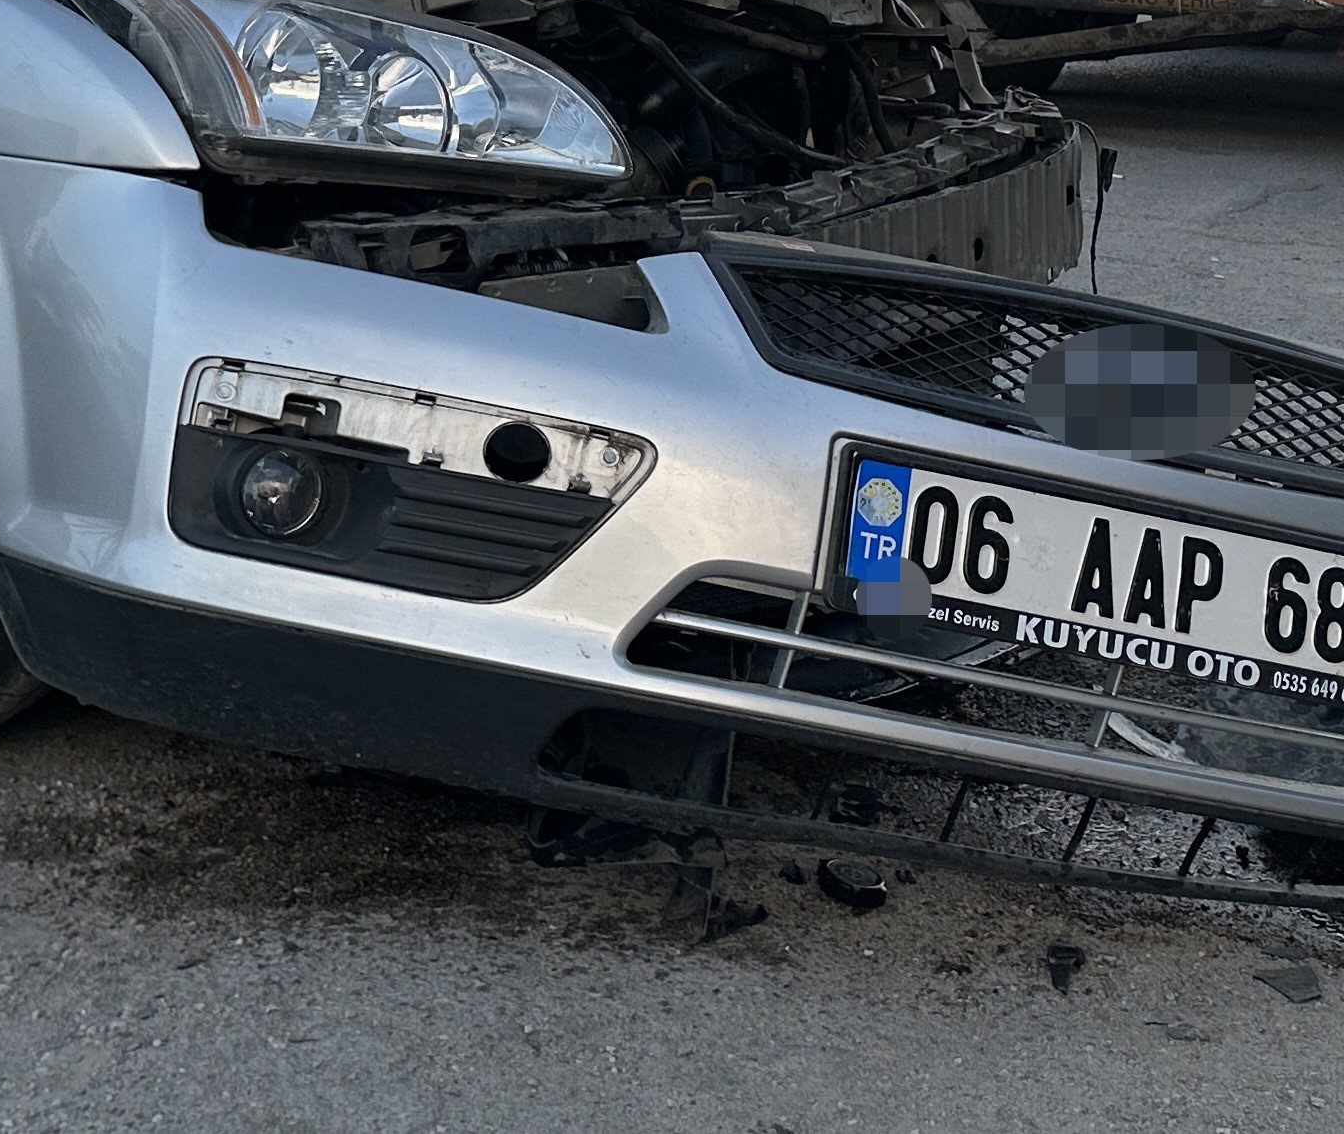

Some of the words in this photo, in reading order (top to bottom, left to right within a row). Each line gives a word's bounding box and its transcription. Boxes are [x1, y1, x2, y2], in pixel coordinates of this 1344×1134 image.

[860, 531, 897, 560] TR
[908, 485, 1014, 595] 06
[1070, 517, 1223, 635] AAP
[928, 607, 950, 622] zel
[953, 609, 1000, 632] Servis
[1016, 614, 1176, 670] KUYUCU
[1187, 650, 1261, 687] OTO
[1273, 671, 1307, 694] 0535
[1311, 677, 1338, 700] 649
